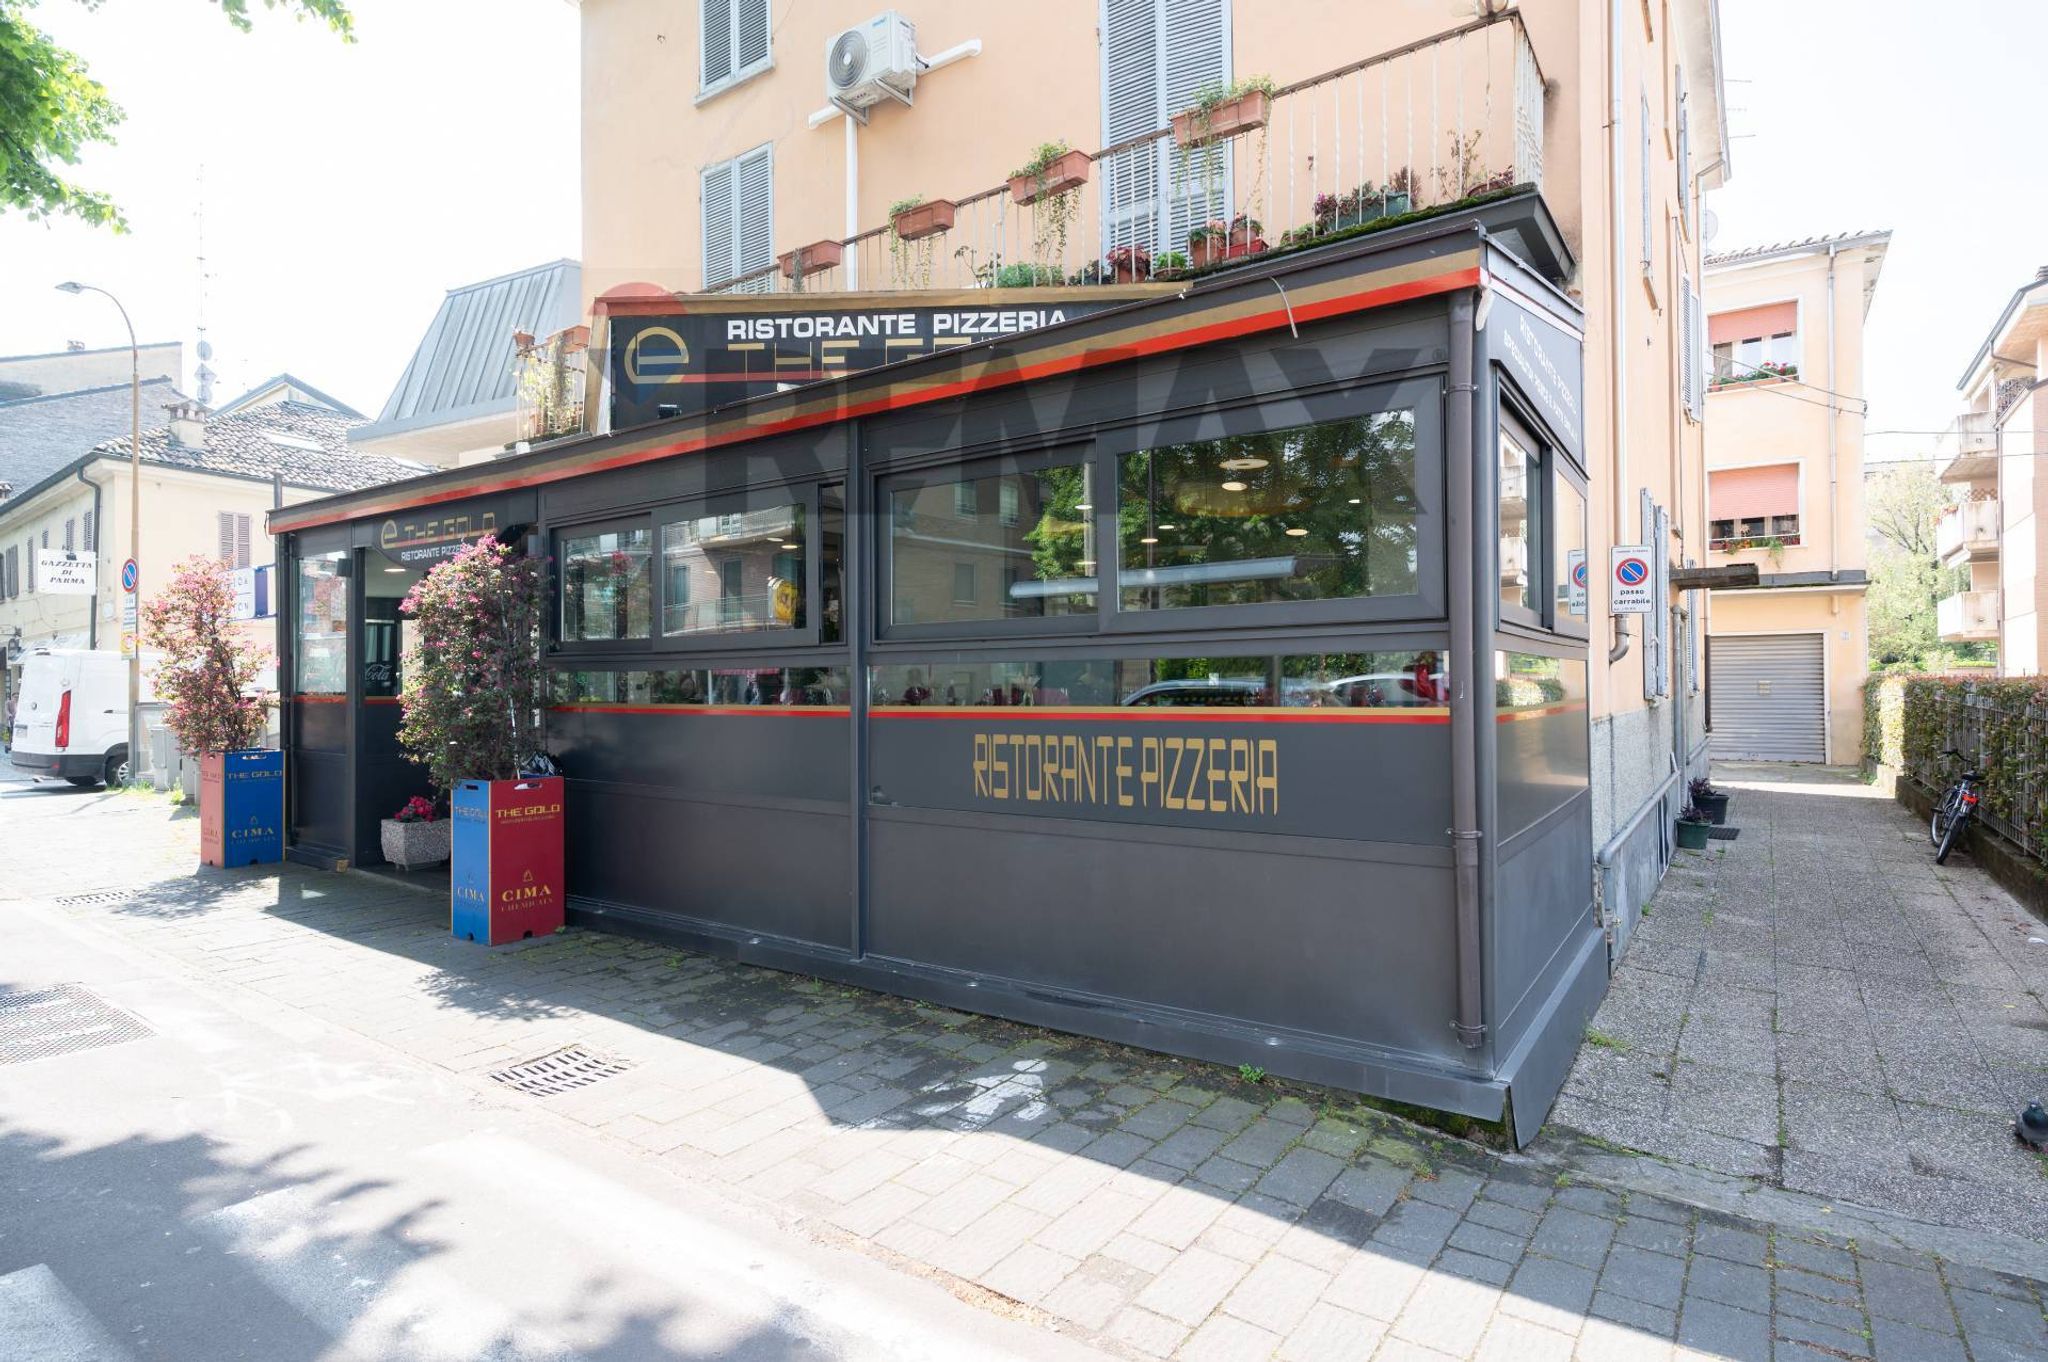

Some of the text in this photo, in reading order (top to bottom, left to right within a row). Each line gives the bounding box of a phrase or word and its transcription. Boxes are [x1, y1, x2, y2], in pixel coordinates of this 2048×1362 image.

[728, 310, 1067, 340] RISTORANTE PIZZERIA
[404, 521, 439, 546] THE
[443, 512, 496, 540] GOLD
[401, 547, 441, 561] RISTORANTE
[41, 560, 92, 568] GAZZETTA
[228, 771, 249, 780] THE
[251, 770, 282, 779] GOLD
[973, 734, 1278, 816] RISTORANTE PIZZERIA
[496, 804, 560, 819] THE GOLD
[231, 827, 274, 839] CIMA
[457, 887, 485, 902] CIMA
[502, 884, 552, 902] CIMA
